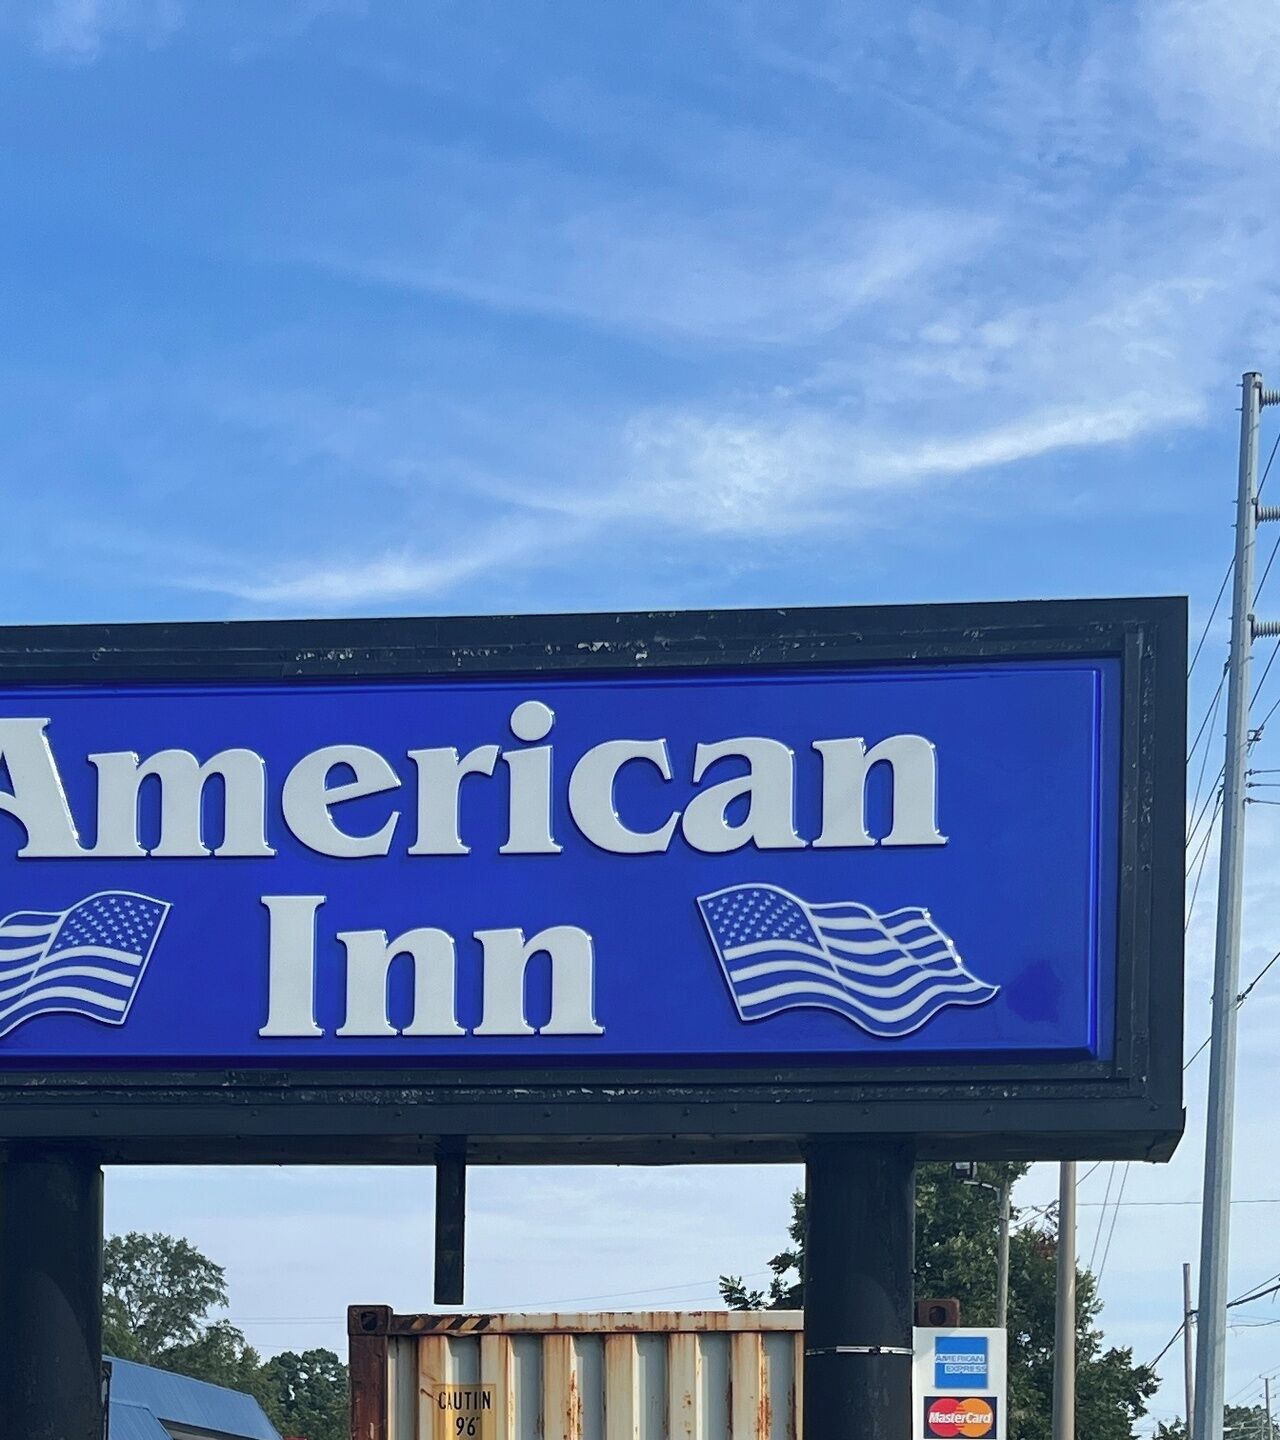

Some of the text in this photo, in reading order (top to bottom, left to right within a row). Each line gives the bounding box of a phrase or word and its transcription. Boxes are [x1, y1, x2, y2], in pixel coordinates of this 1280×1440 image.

[257, 893, 606, 1039] Inn
[935, 1354, 985, 1364] AMERICAN
[944, 1364, 988, 1374] EXPRESS
[438, 1390, 491, 1410] CAUTIN
[928, 1411, 992, 1425] MasterCard
